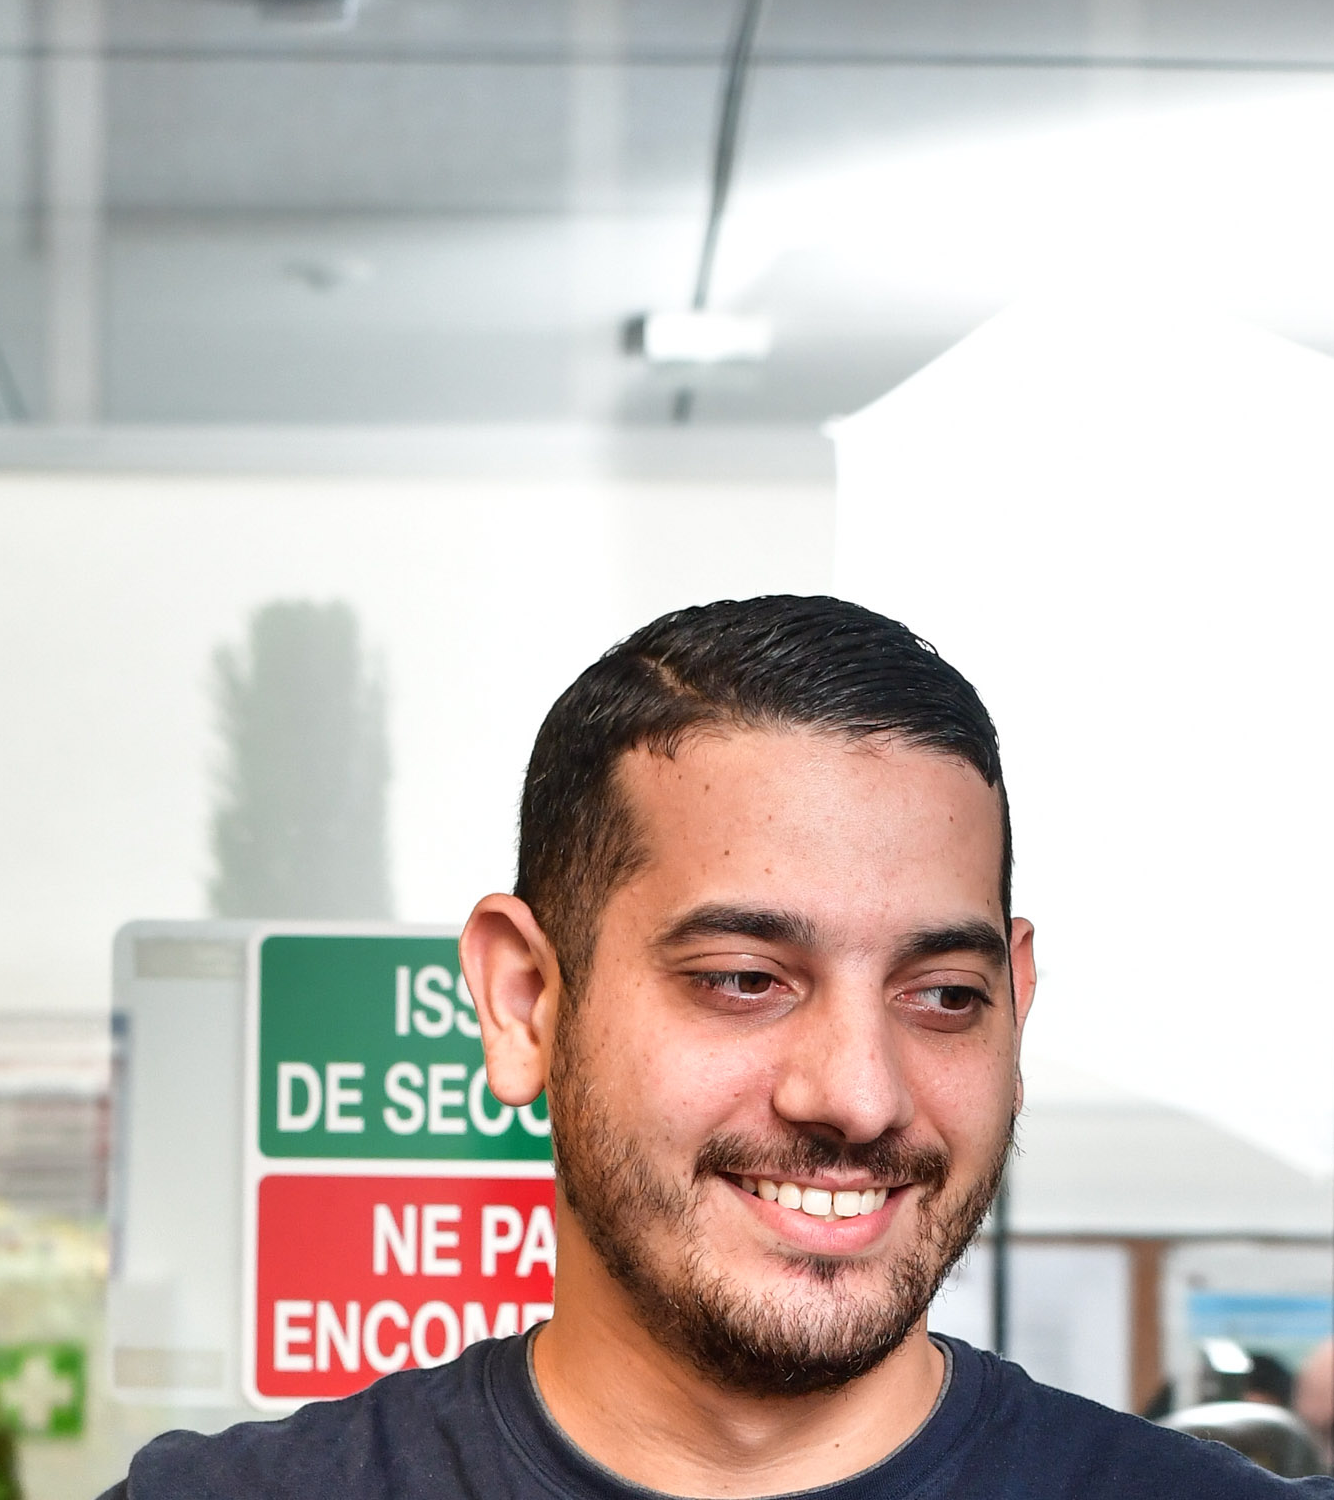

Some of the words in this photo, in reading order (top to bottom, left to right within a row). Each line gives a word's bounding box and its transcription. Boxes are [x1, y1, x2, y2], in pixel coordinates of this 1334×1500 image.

[276, 1062, 366, 1133] DE
[372, 1203, 463, 1277] NE
[273, 1300, 555, 1373] ENCOM
